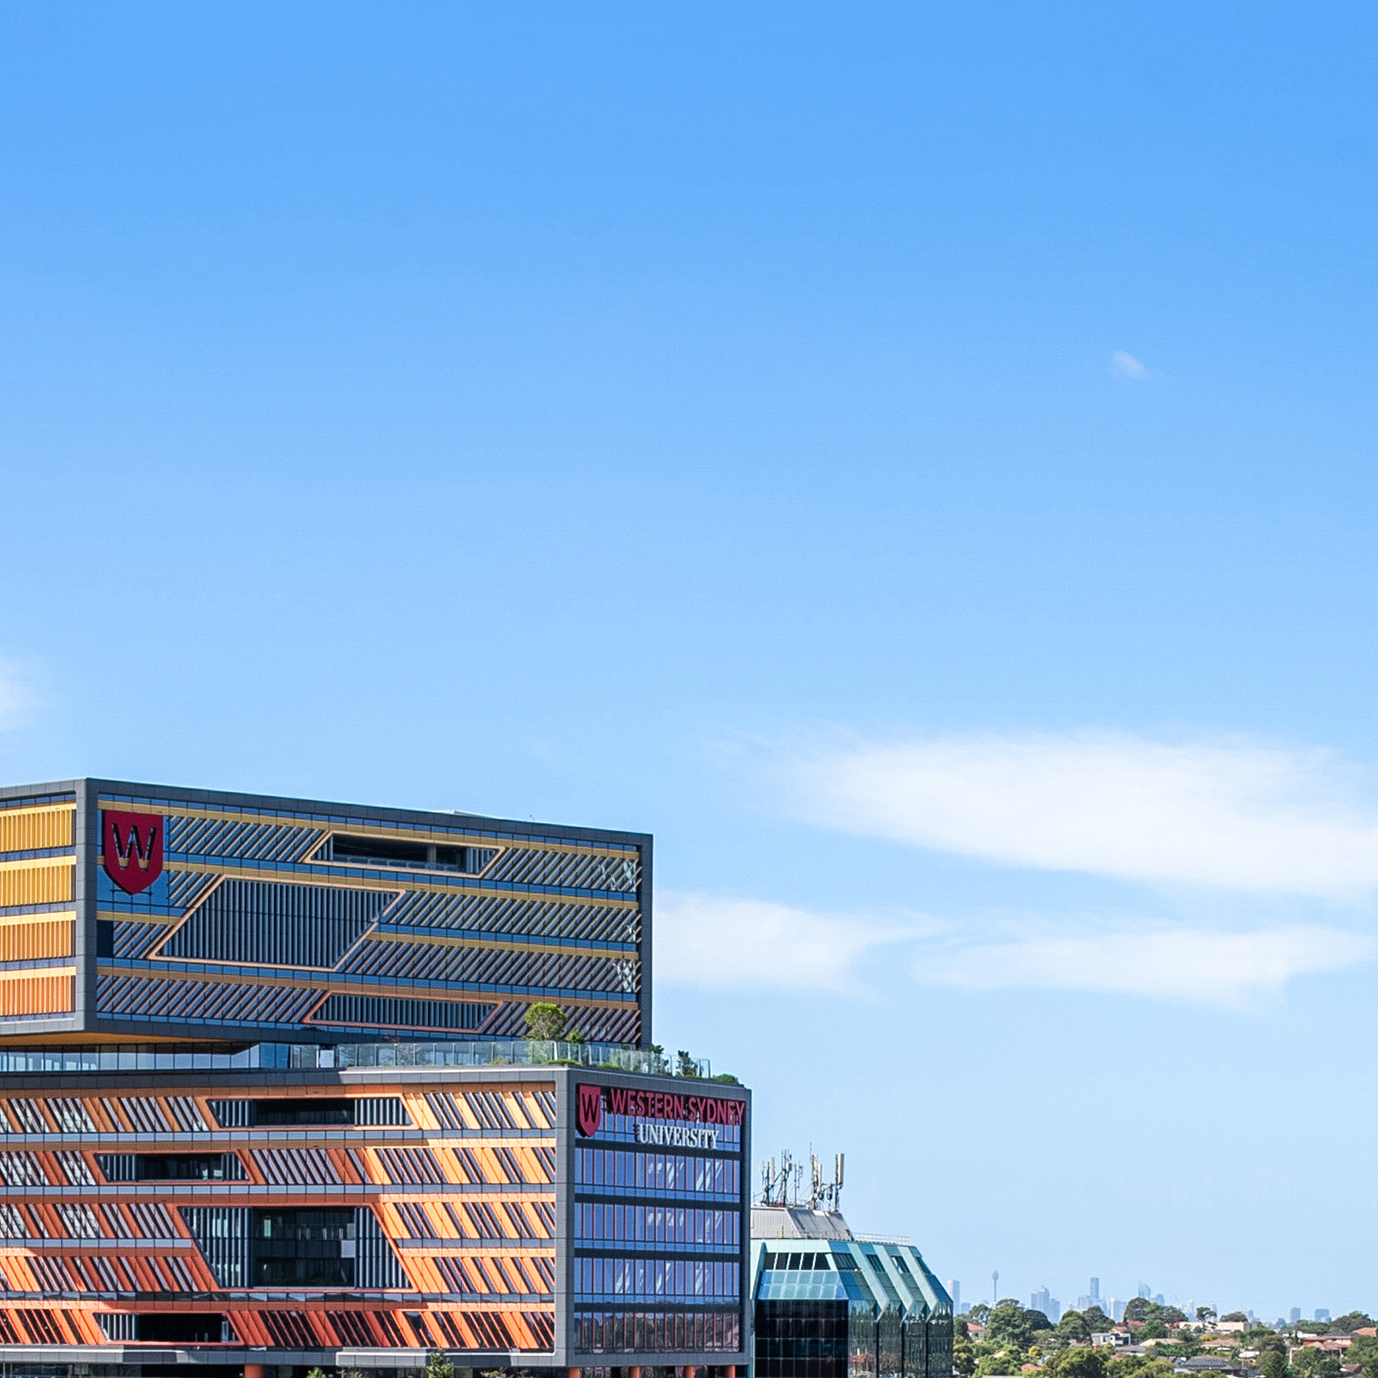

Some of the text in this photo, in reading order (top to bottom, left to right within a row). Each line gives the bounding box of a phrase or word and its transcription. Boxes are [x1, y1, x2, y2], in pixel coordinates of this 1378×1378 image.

[111, 822, 157, 872] W
[581, 1092, 601, 1124] W
[610, 1087, 746, 1127] WESTERN SYDNEY
[638, 1122, 720, 1150] UNIVERSITY
